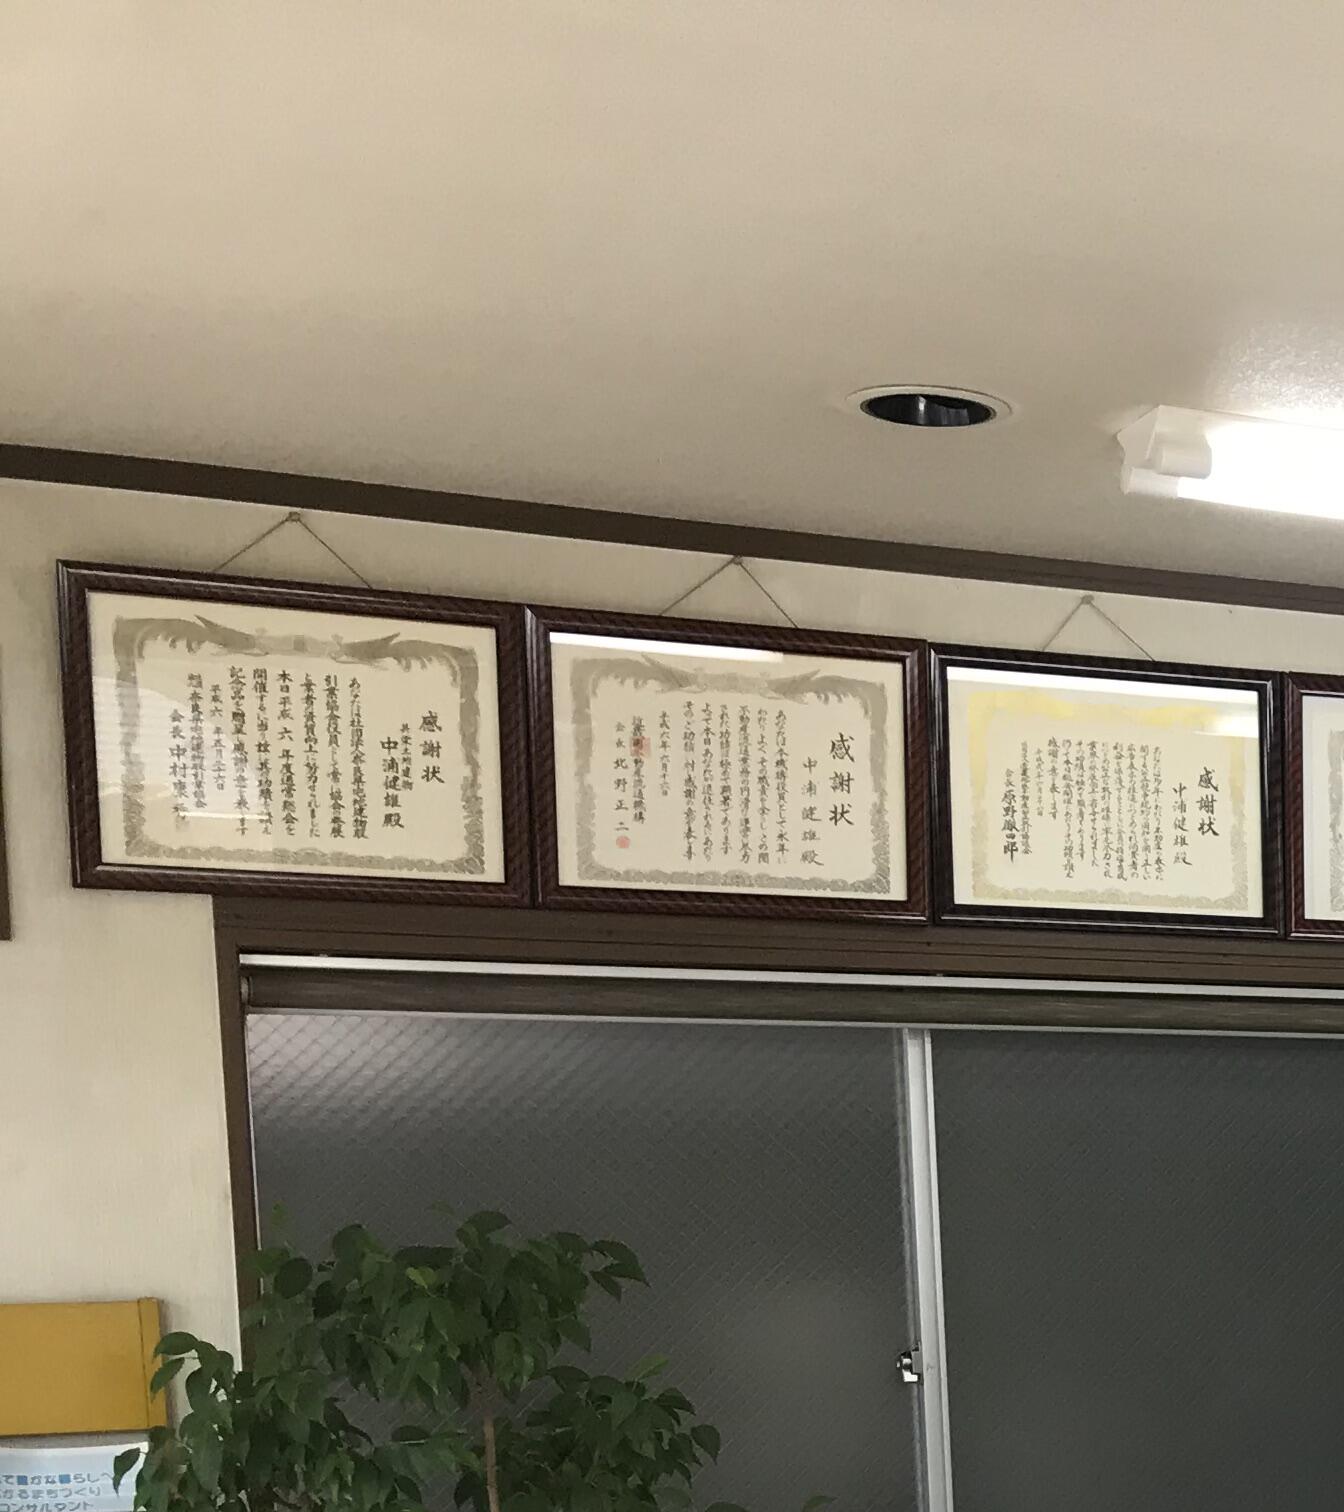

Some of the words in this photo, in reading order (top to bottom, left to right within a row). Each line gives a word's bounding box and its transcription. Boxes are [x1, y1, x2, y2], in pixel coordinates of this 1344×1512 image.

[419, 710, 445, 784] 感謝状
[829, 732, 855, 826] 感謝状
[1196, 766, 1220, 837] 感謝状
